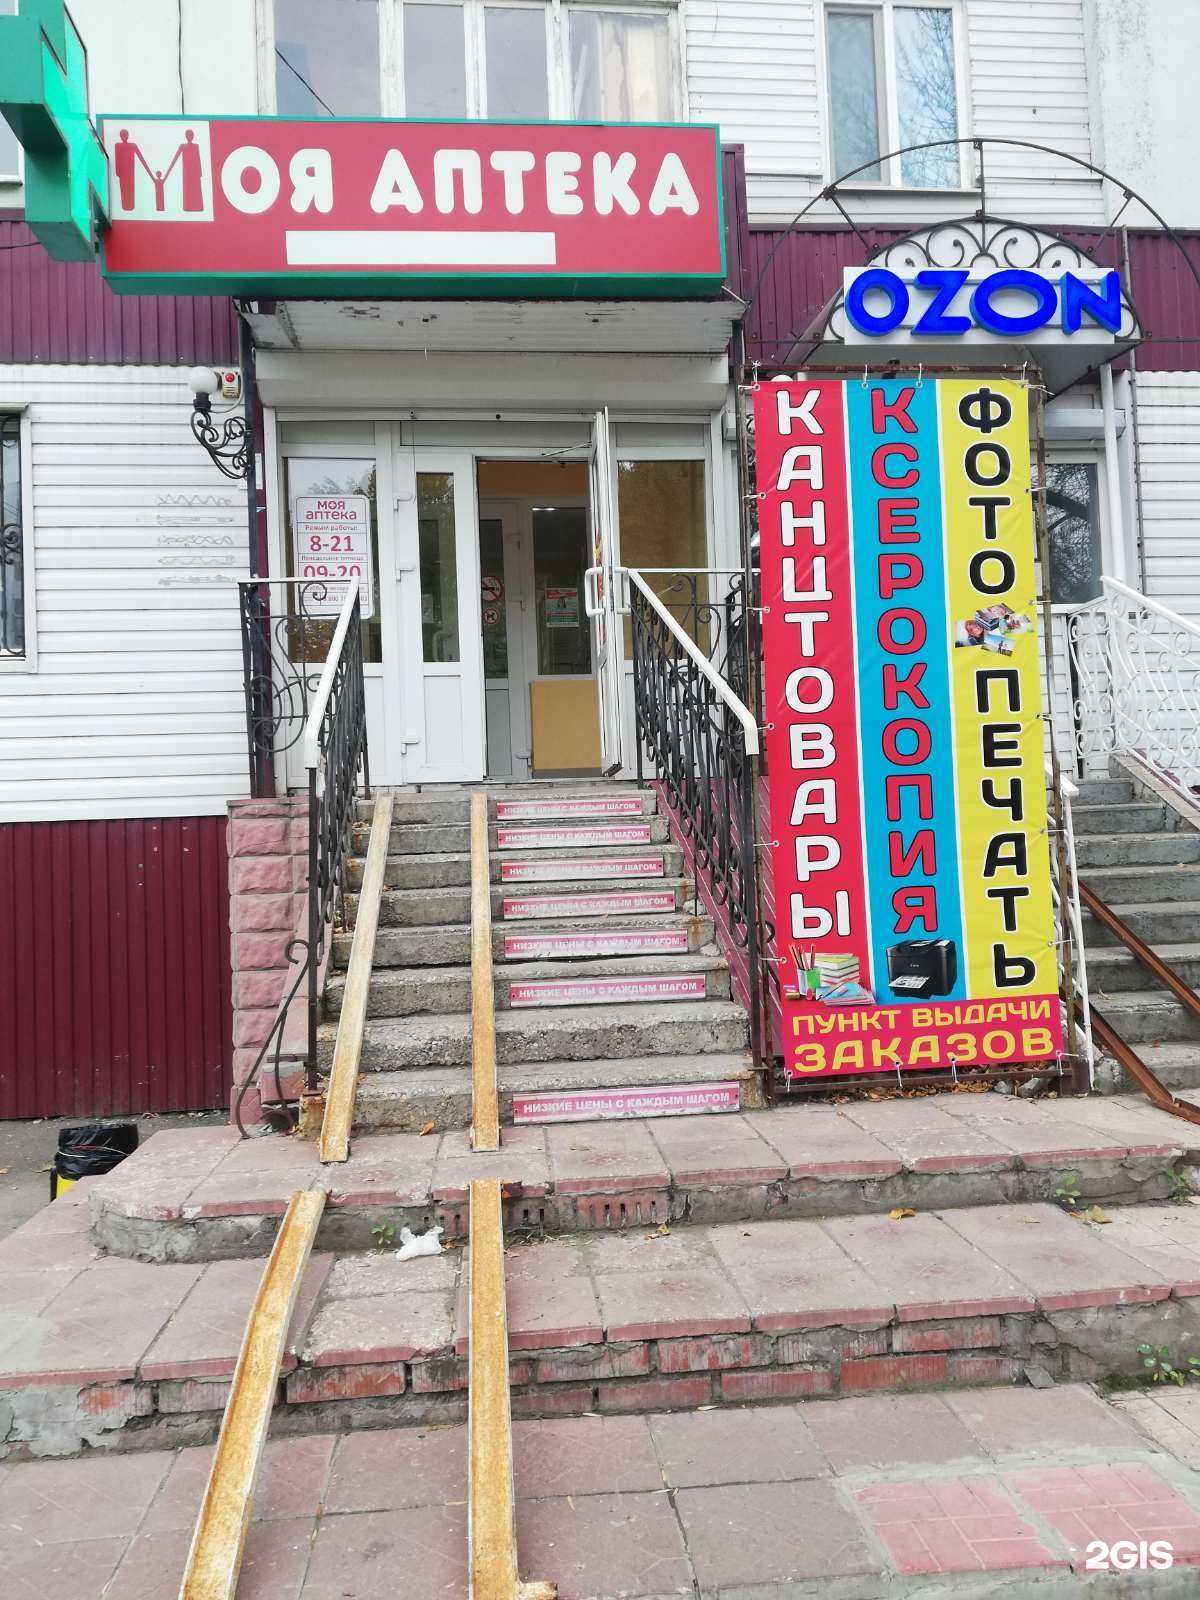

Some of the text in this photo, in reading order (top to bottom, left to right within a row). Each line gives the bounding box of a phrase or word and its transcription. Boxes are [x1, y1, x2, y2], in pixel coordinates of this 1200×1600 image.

[370, 148, 699, 216] АПТЕКА
[844, 268, 1122, 336] OZON
[305, 510, 357, 520] аптека
[310, 535, 354, 551] 8-21
[775, 388, 851, 939] КАНЦТОВАРЫ
[870, 387, 939, 934] КСЕРОКОПИЯ
[957, 387, 1037, 989] ФОТО ПЕЧАТЬ
[607, 984, 657, 995] КАЖДЫМ
[659, 982, 697, 992] ШАГОМ
[792, 999, 1051, 1036] ПУНКТ ВЫДАЧИ
[794, 1027, 1054, 1073] ЗАКАЗОВ
[524, 1092, 730, 1113] НИЗКИЕ ЦЕНЫ С КАЖДЫМ ШАГОМ
